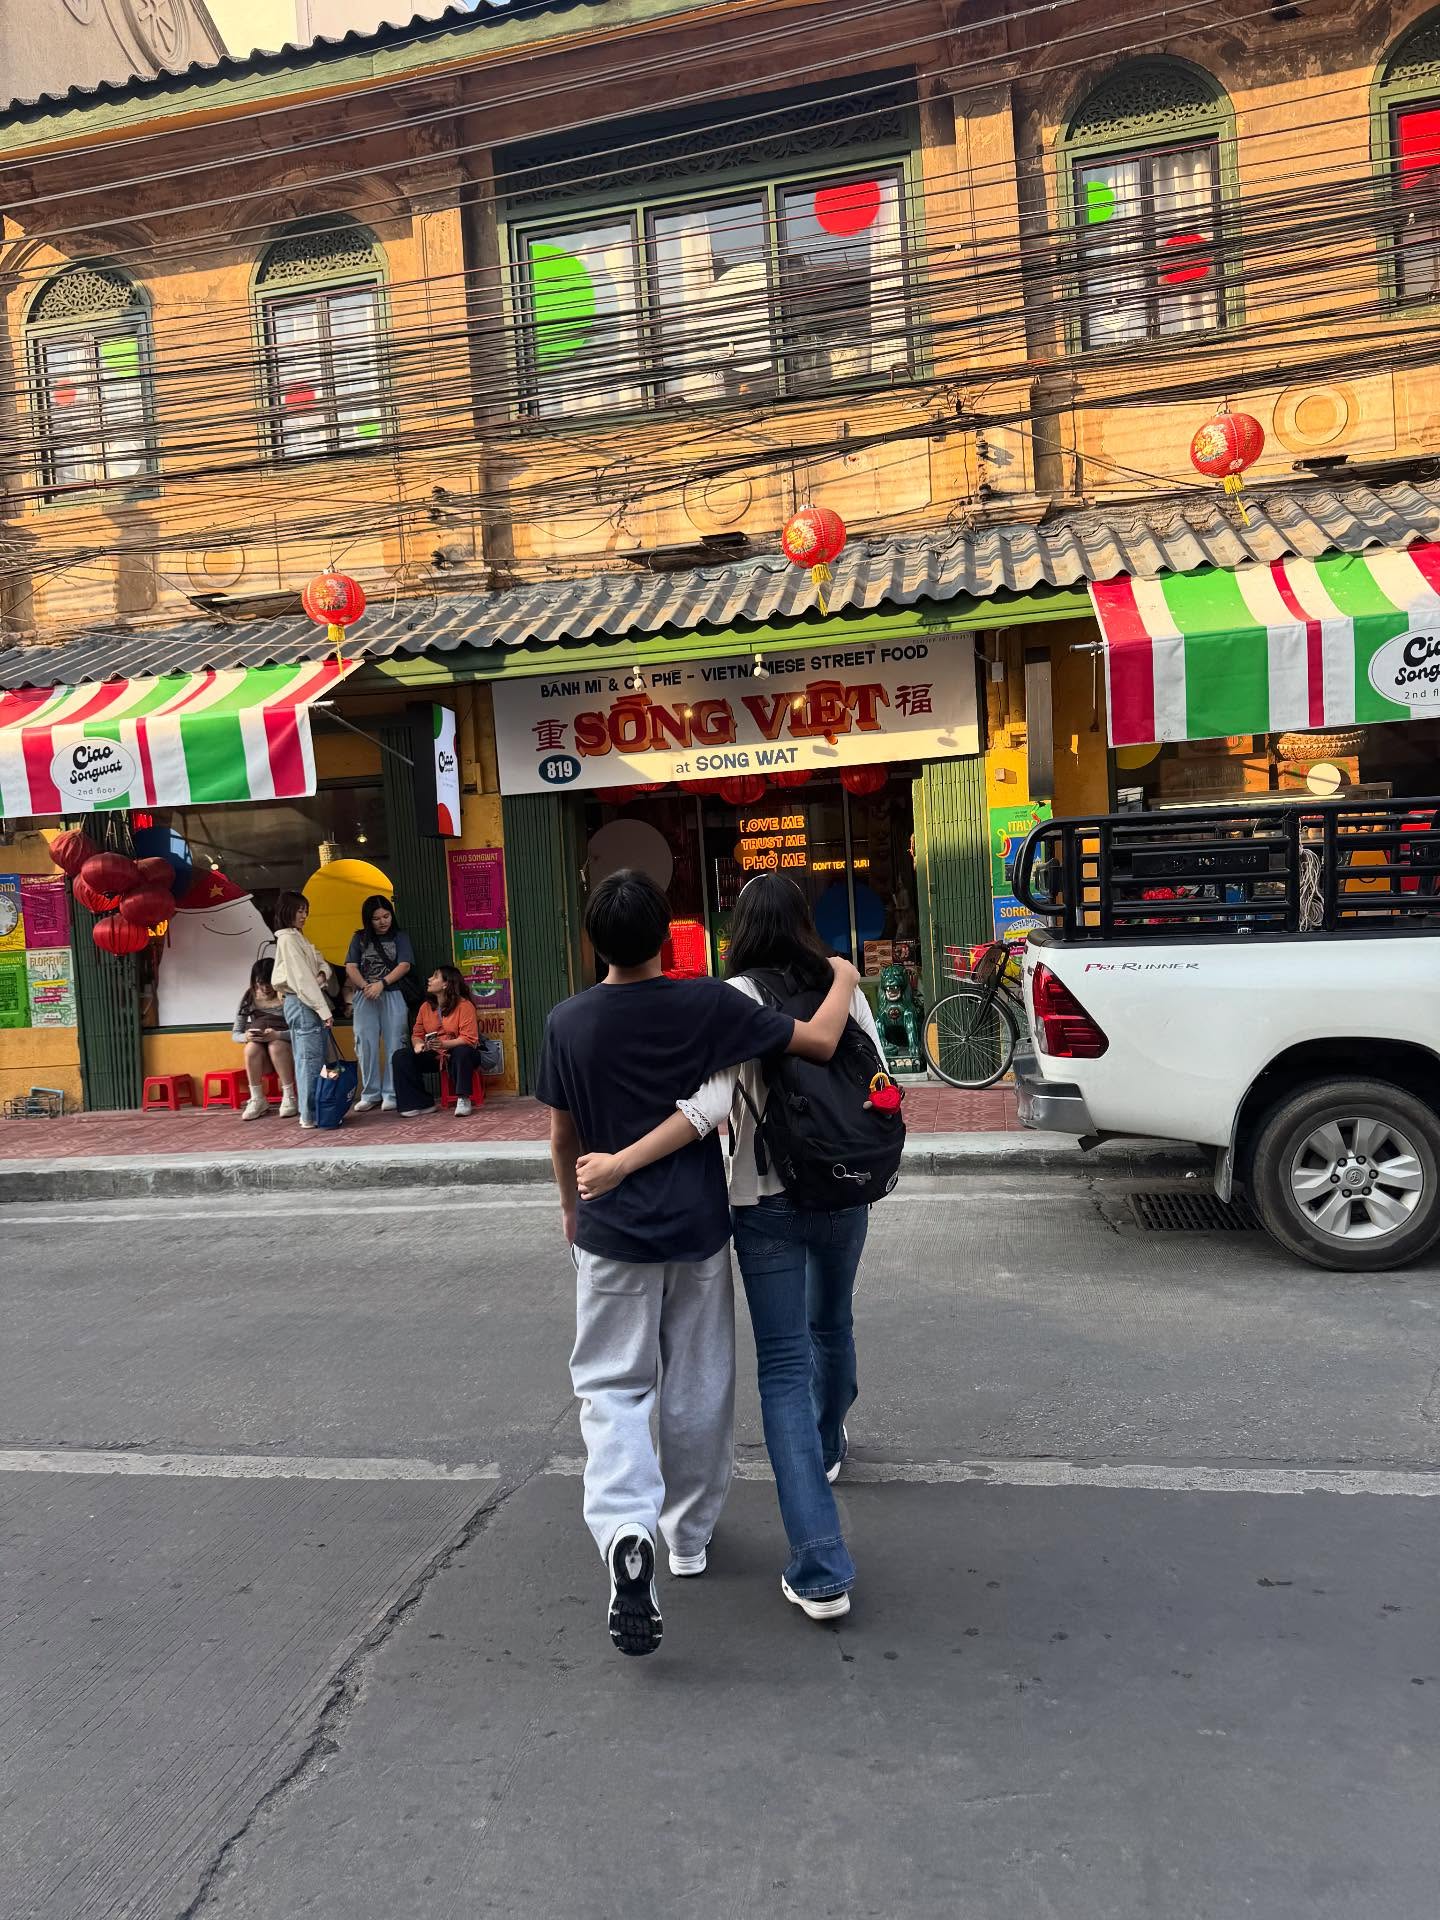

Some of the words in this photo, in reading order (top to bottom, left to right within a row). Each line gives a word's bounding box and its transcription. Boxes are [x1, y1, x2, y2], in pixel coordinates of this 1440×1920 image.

[609, 678, 619, 691] &
[811, 650, 875, 670] STREET
[880, 644, 929, 663] FOOD
[895, 683, 934, 717] 福
[1404, 690, 1426, 699] 2nd
[531, 719, 568, 752] 重
[72, 745, 113, 770] Ciao
[439, 751, 453, 773] Ciao
[676, 761, 691, 774] at
[696, 752, 748, 772] SONG
[755, 747, 799, 767] WAT
[70, 759, 122, 784] Songwat
[547, 760, 573, 778] 819
[77, 788, 93, 796] 2nd
[781, 815, 805, 830] ME
[1007, 820, 1033, 832] ITALY
[741, 835, 783, 850] TRUST
[785, 834, 807, 847] ME
[468, 852, 498, 862] SONGWAT
[781, 852, 807, 867] ME
[832, 860, 845, 870] TEX
[1000, 907, 1034, 918] SORRE
[463, 936, 498, 950] MILAN
[478, 1018, 505, 1033] OME
